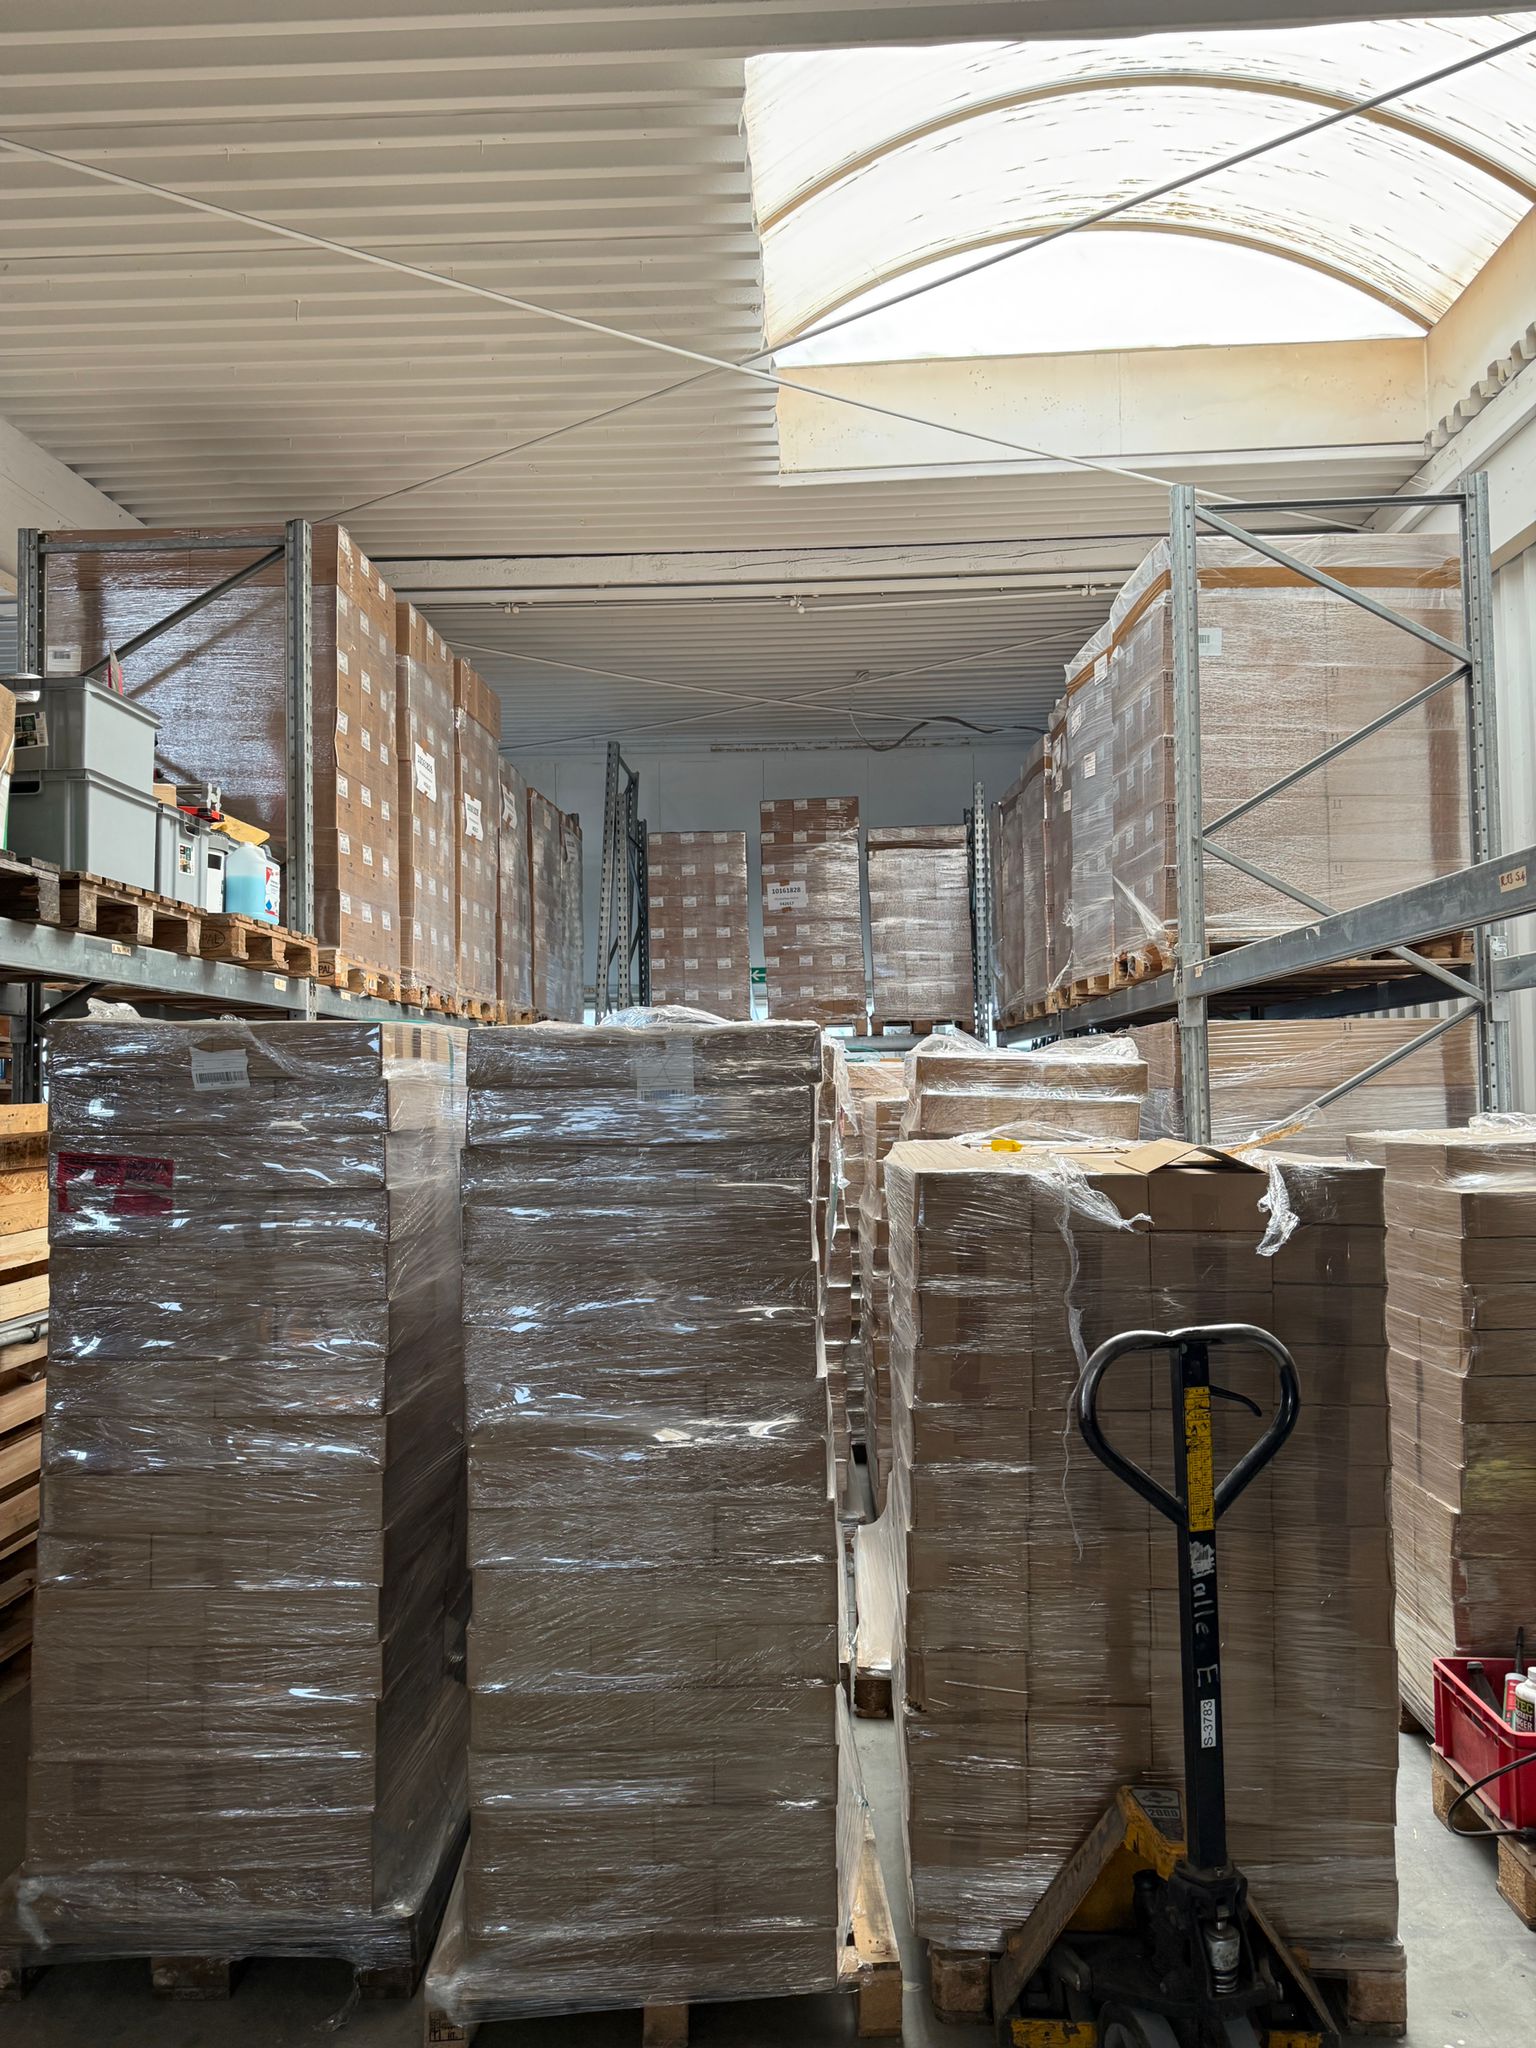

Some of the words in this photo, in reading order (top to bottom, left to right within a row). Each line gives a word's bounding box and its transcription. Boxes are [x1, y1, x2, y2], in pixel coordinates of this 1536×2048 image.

[201, 934, 220, 945] PAL
[318, 965, 331, 974] PAL
[1202, 1700, 1214, 1746] S-3783
